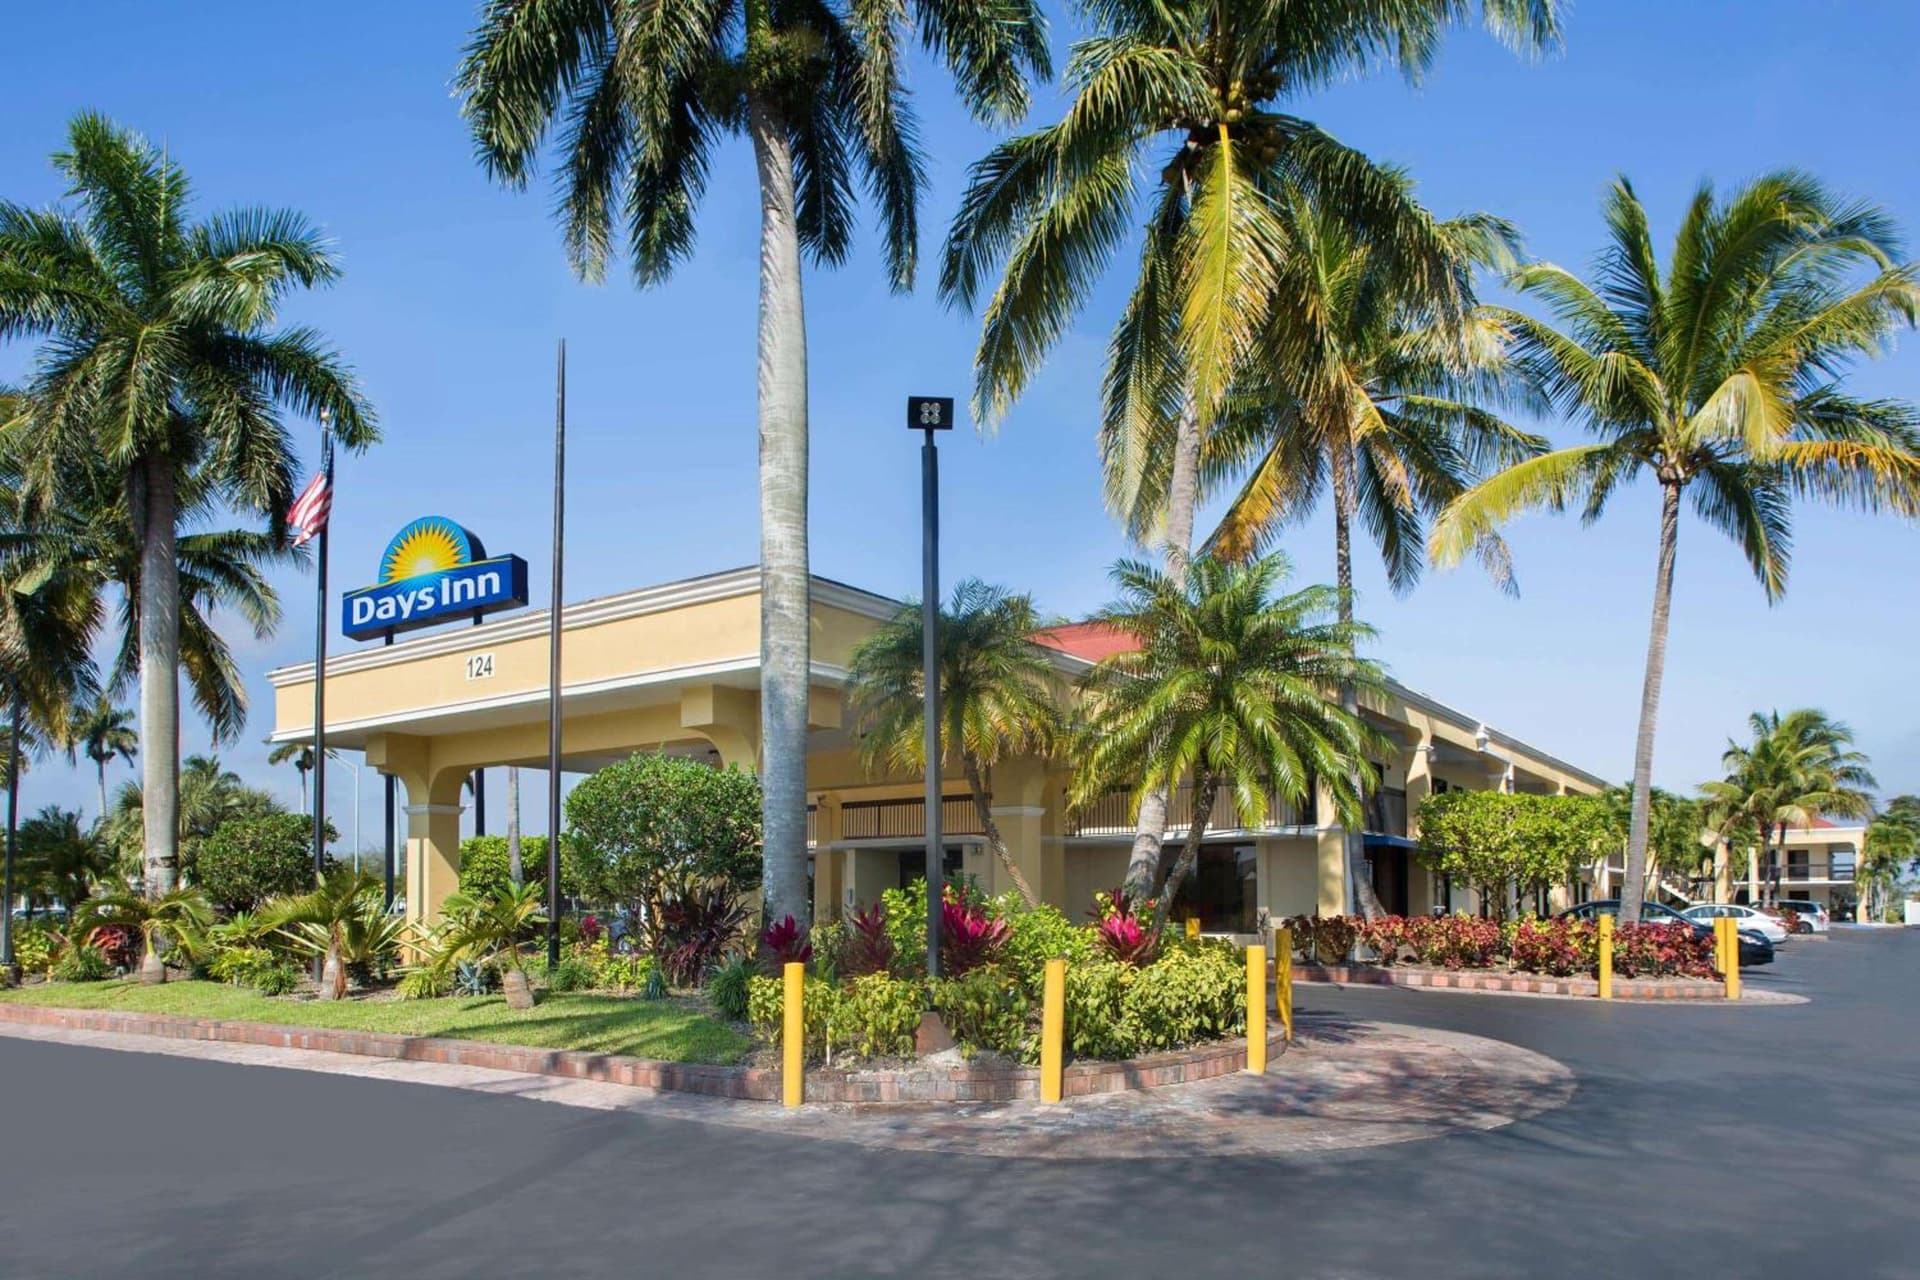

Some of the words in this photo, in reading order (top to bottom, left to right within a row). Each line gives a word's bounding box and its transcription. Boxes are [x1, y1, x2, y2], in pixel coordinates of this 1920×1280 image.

[352, 587, 435, 625] Days
[441, 571, 500, 606] Inn
[467, 655, 493, 678] 124
